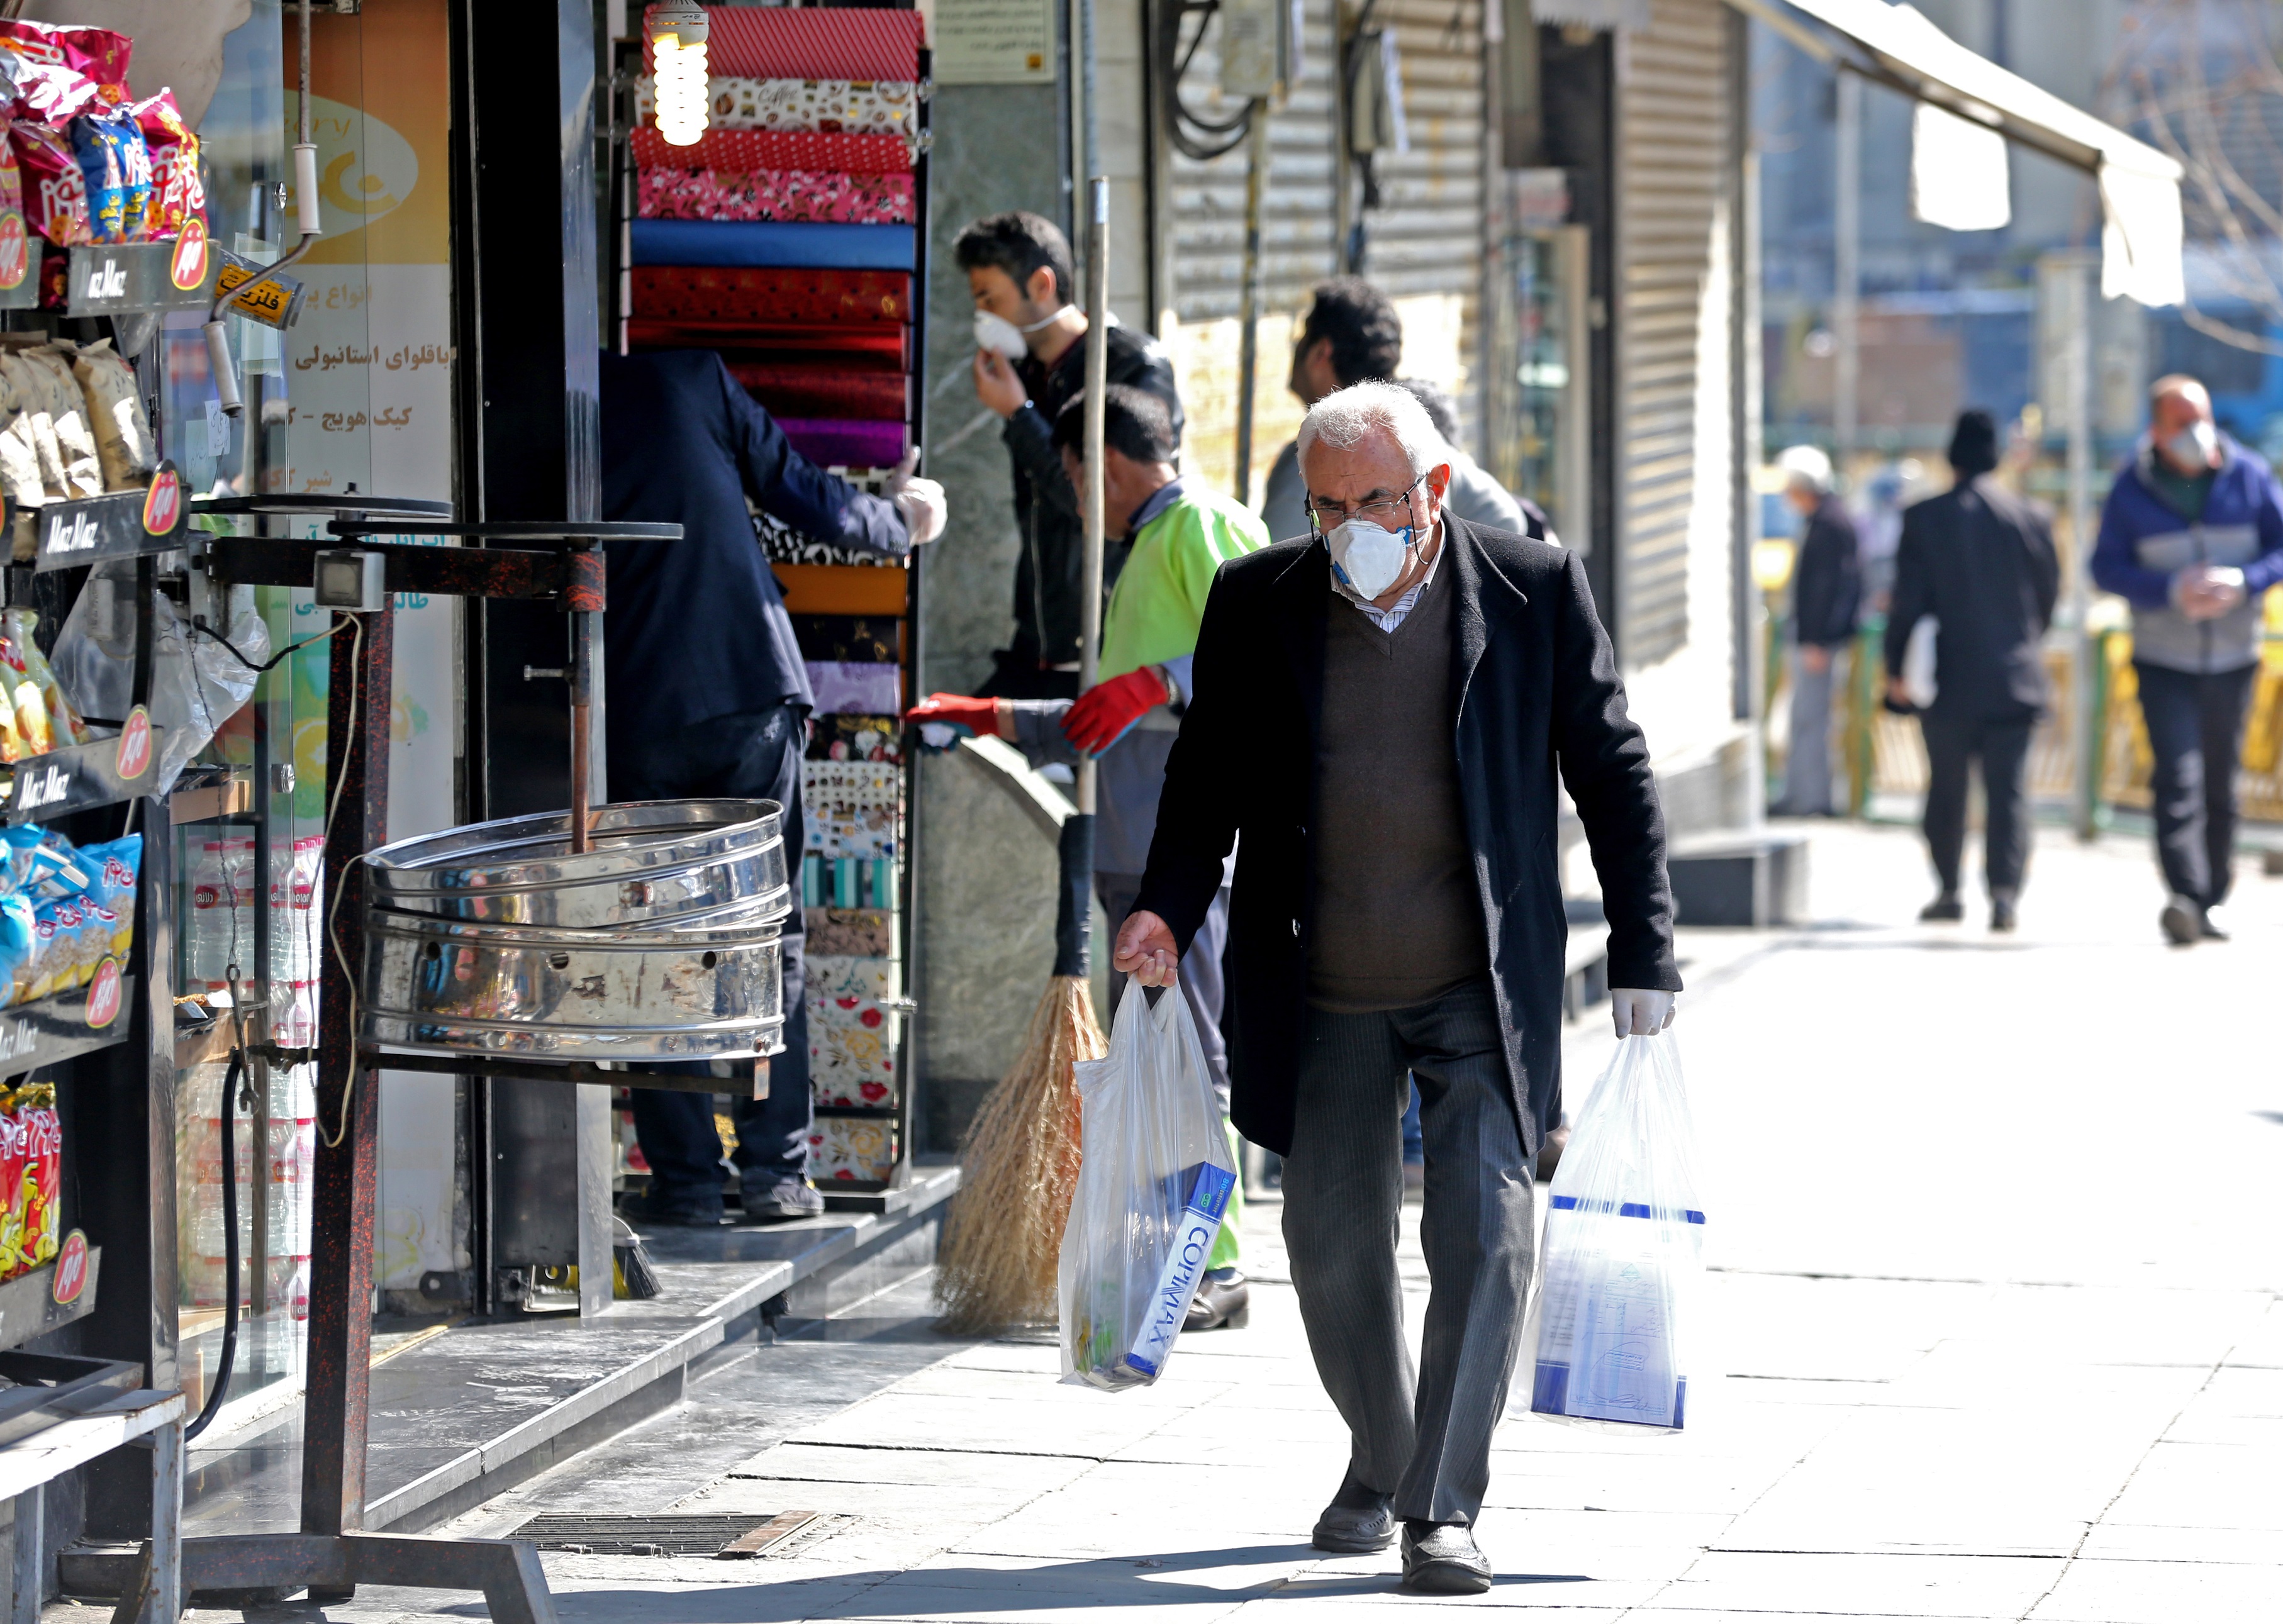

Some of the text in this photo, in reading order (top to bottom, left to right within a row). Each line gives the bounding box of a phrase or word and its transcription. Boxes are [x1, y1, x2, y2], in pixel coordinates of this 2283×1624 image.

[325, 282, 373, 309] انواع
[295, 344, 450, 370] باقلوای استانبولی
[321, 411, 367, 432] هویج
[373, 407, 412, 430] کیک
[303, 470, 332, 492] شیر
[1220, 1177, 1229, 1189] 80
[1212, 1189, 1224, 1213] EXECUTIVE
[1149, 1226, 1209, 1344] COPIMAX
